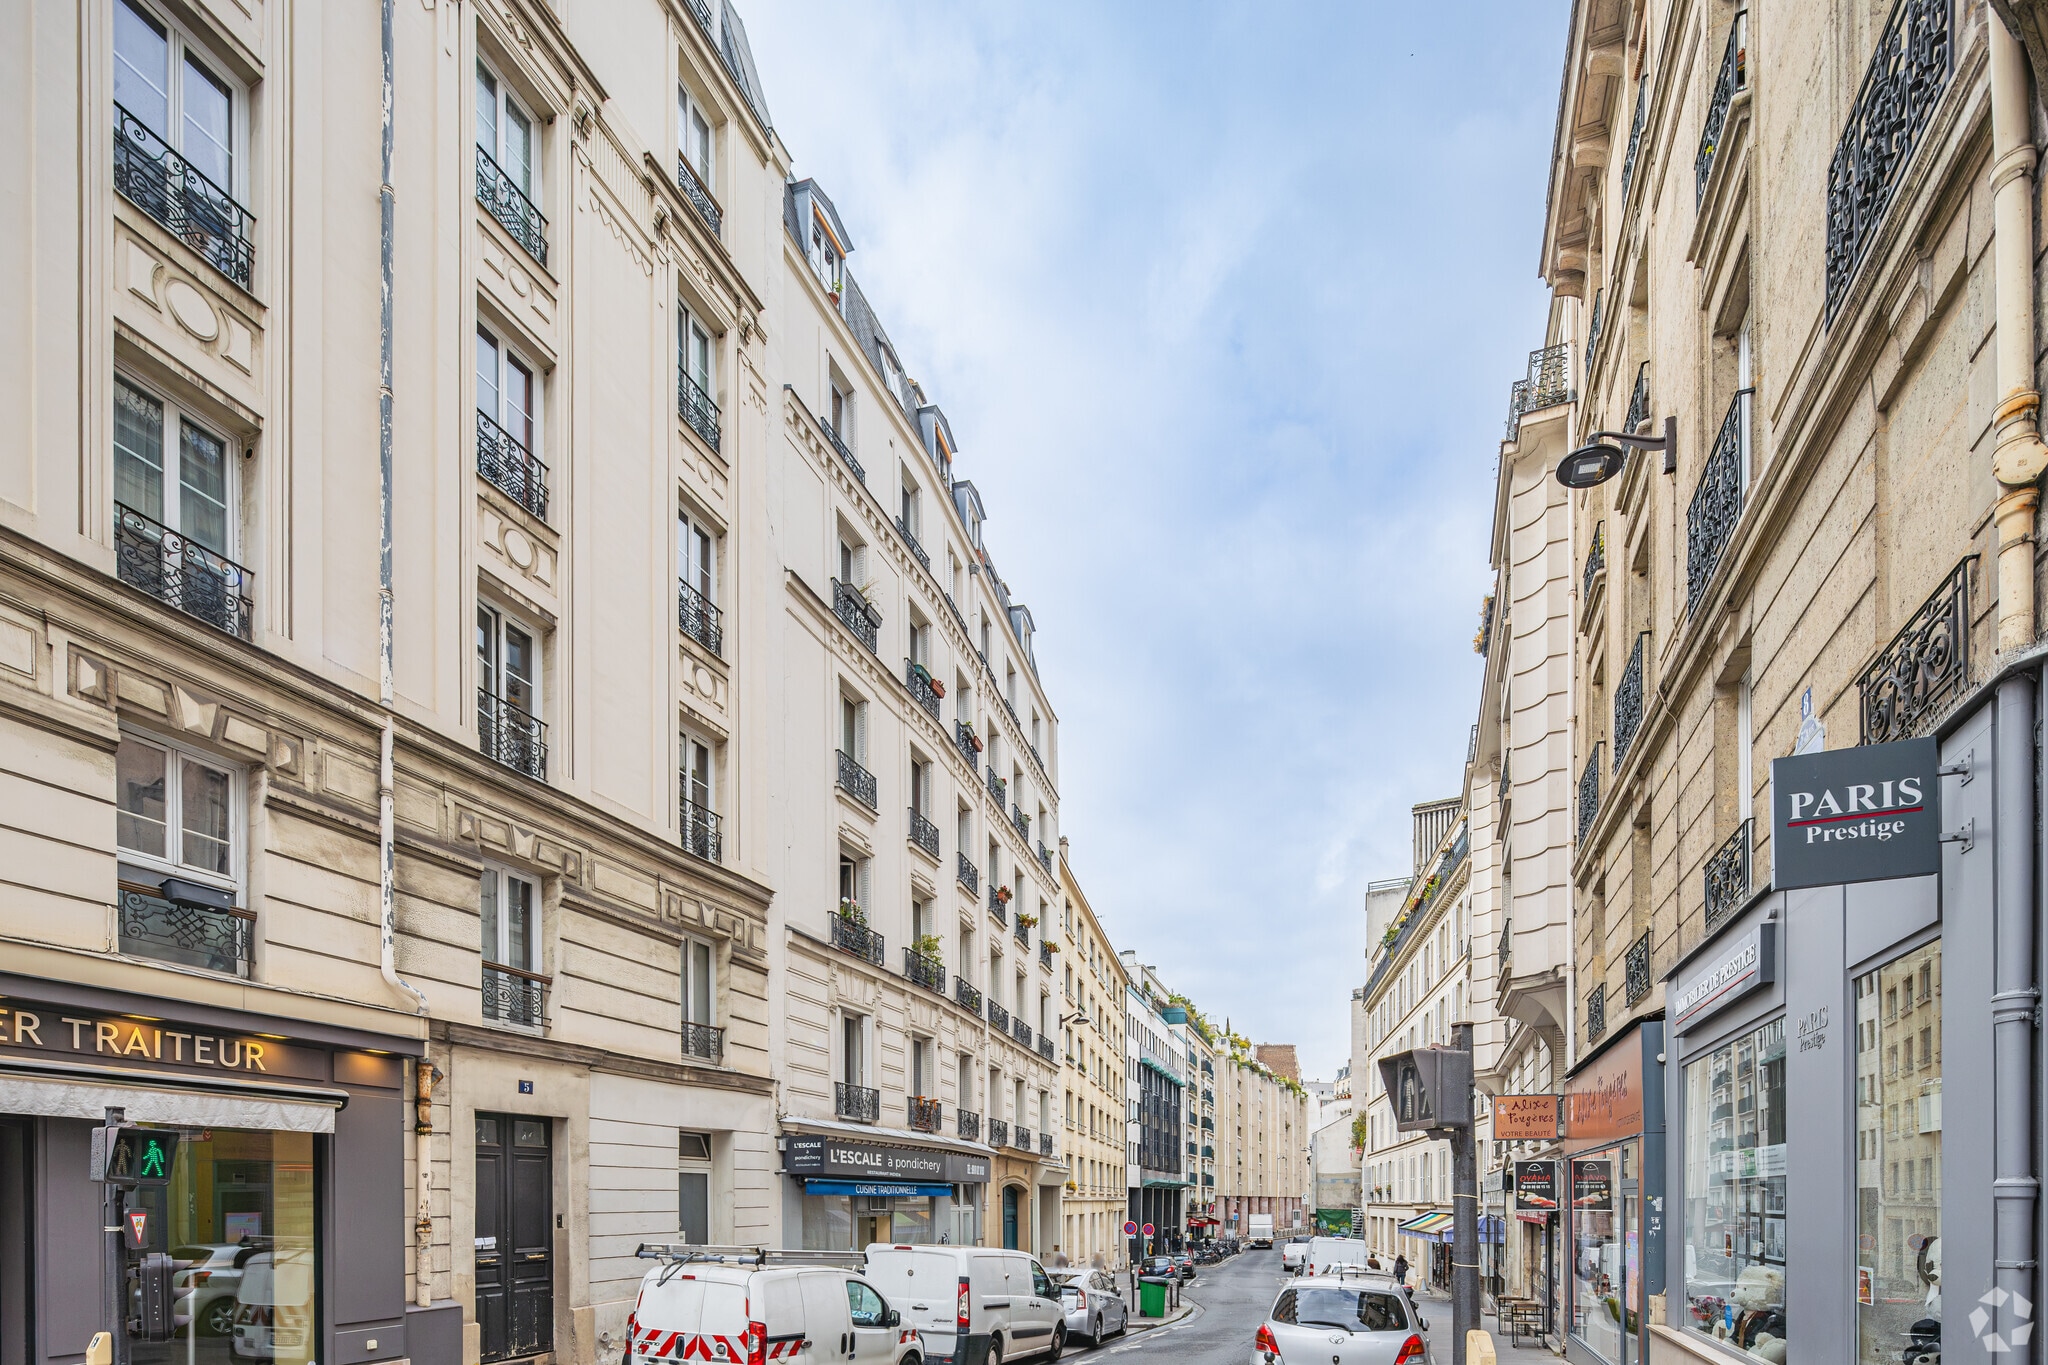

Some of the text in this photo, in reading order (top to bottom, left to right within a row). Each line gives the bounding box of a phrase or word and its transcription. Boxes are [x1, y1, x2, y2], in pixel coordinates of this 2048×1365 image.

[1788, 776, 1923, 820] PARIS
[1806, 819, 1905, 844] Prestige
[1675, 943, 1757, 1017] IMMOBILIER DE PRESTIGE
[1797, 1004, 1829, 1039] PARIS
[61, 1016, 266, 1071] TRAITEUR
[1800, 1032, 1826, 1053] Prestige
[524, 1082, 530, 1092] 5
[1511, 1099, 1550, 1111] Alixe
[1507, 1112, 1554, 1127] Fougères
[1524, 1129, 1551, 1137] BEAUTÉ
[829, 1149, 941, 1174] L'ESCALE à pondichery
[855, 1184, 918, 1196] CUISINE TRADITIONNELLE
